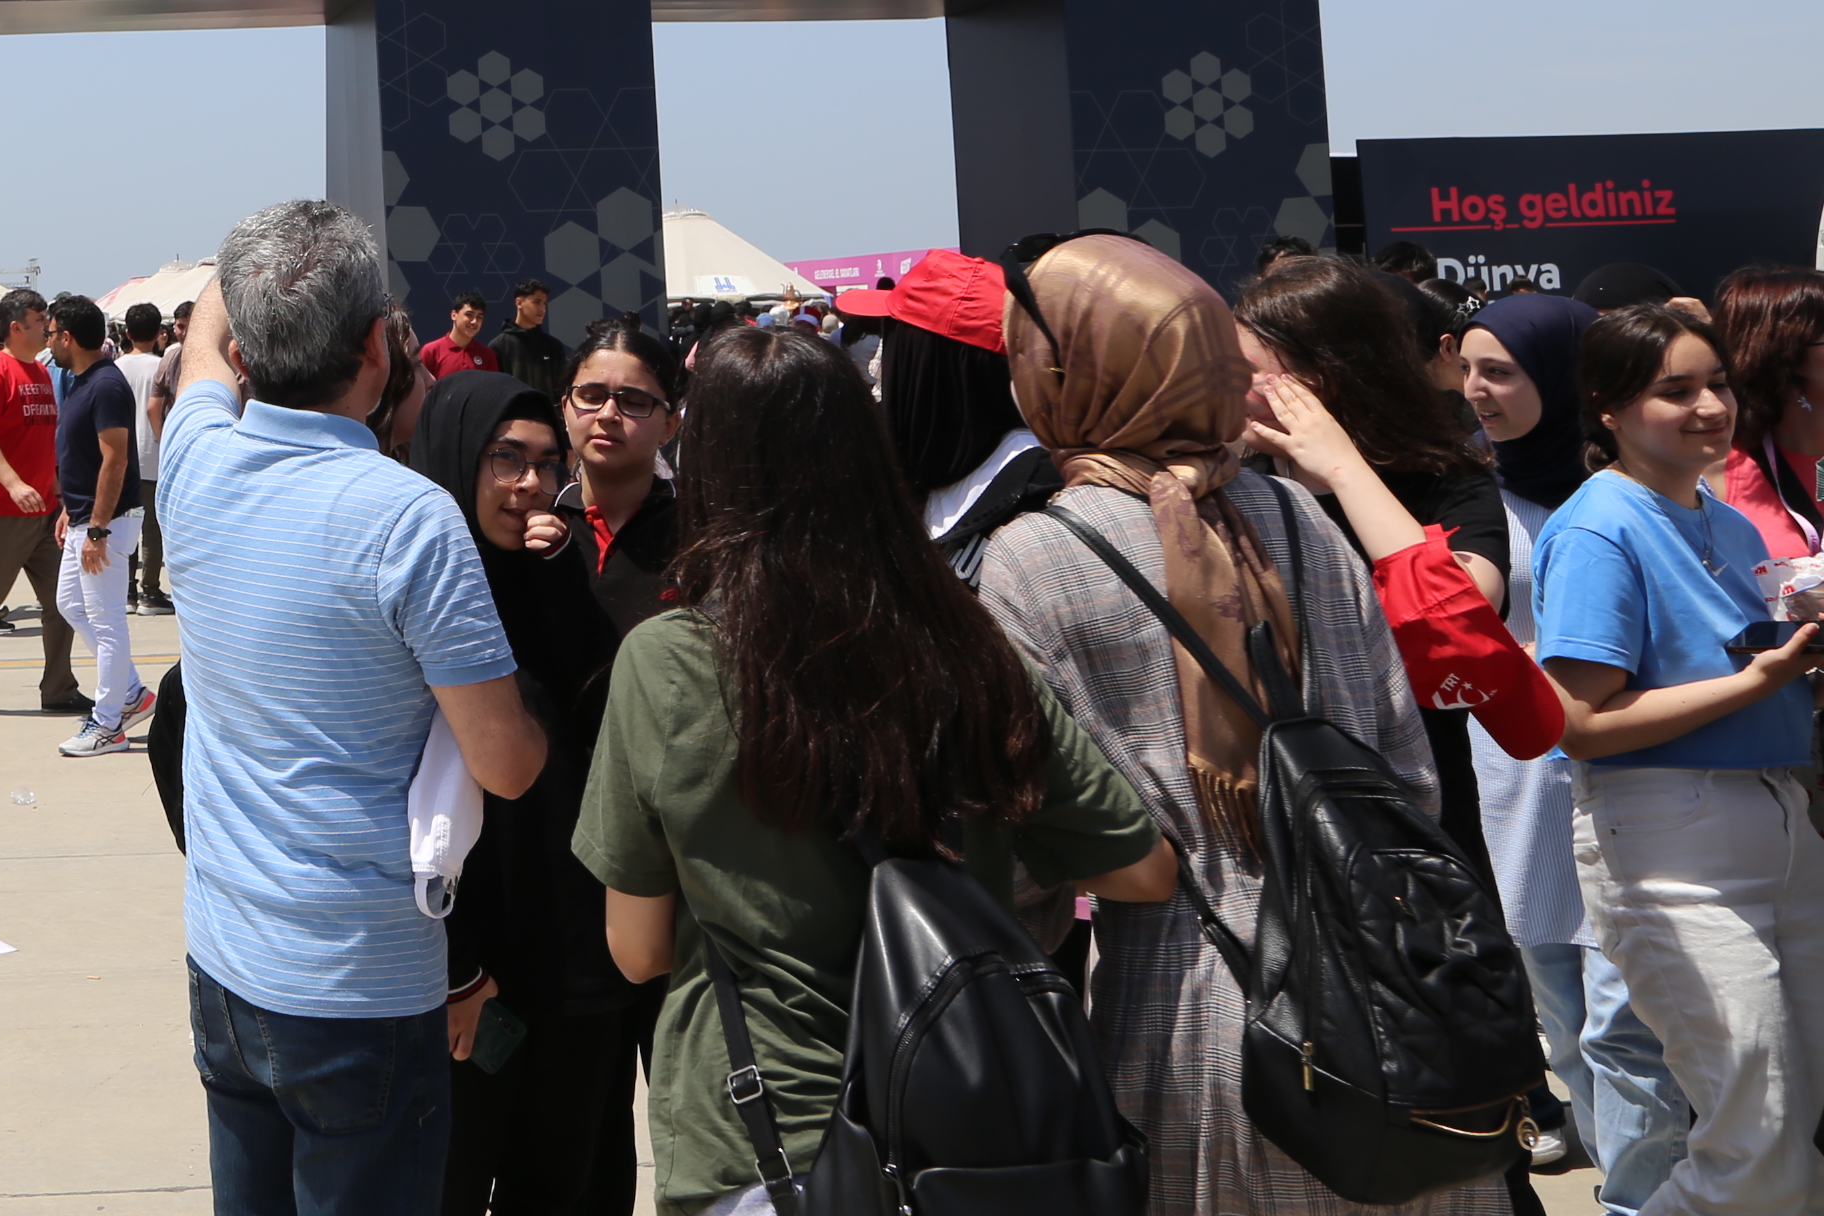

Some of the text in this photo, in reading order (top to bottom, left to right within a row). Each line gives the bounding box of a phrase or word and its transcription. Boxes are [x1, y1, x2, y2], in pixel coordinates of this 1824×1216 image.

[1430, 178, 1677, 231] Hoş geldiniz
[1439, 672, 1461, 693] TRT
